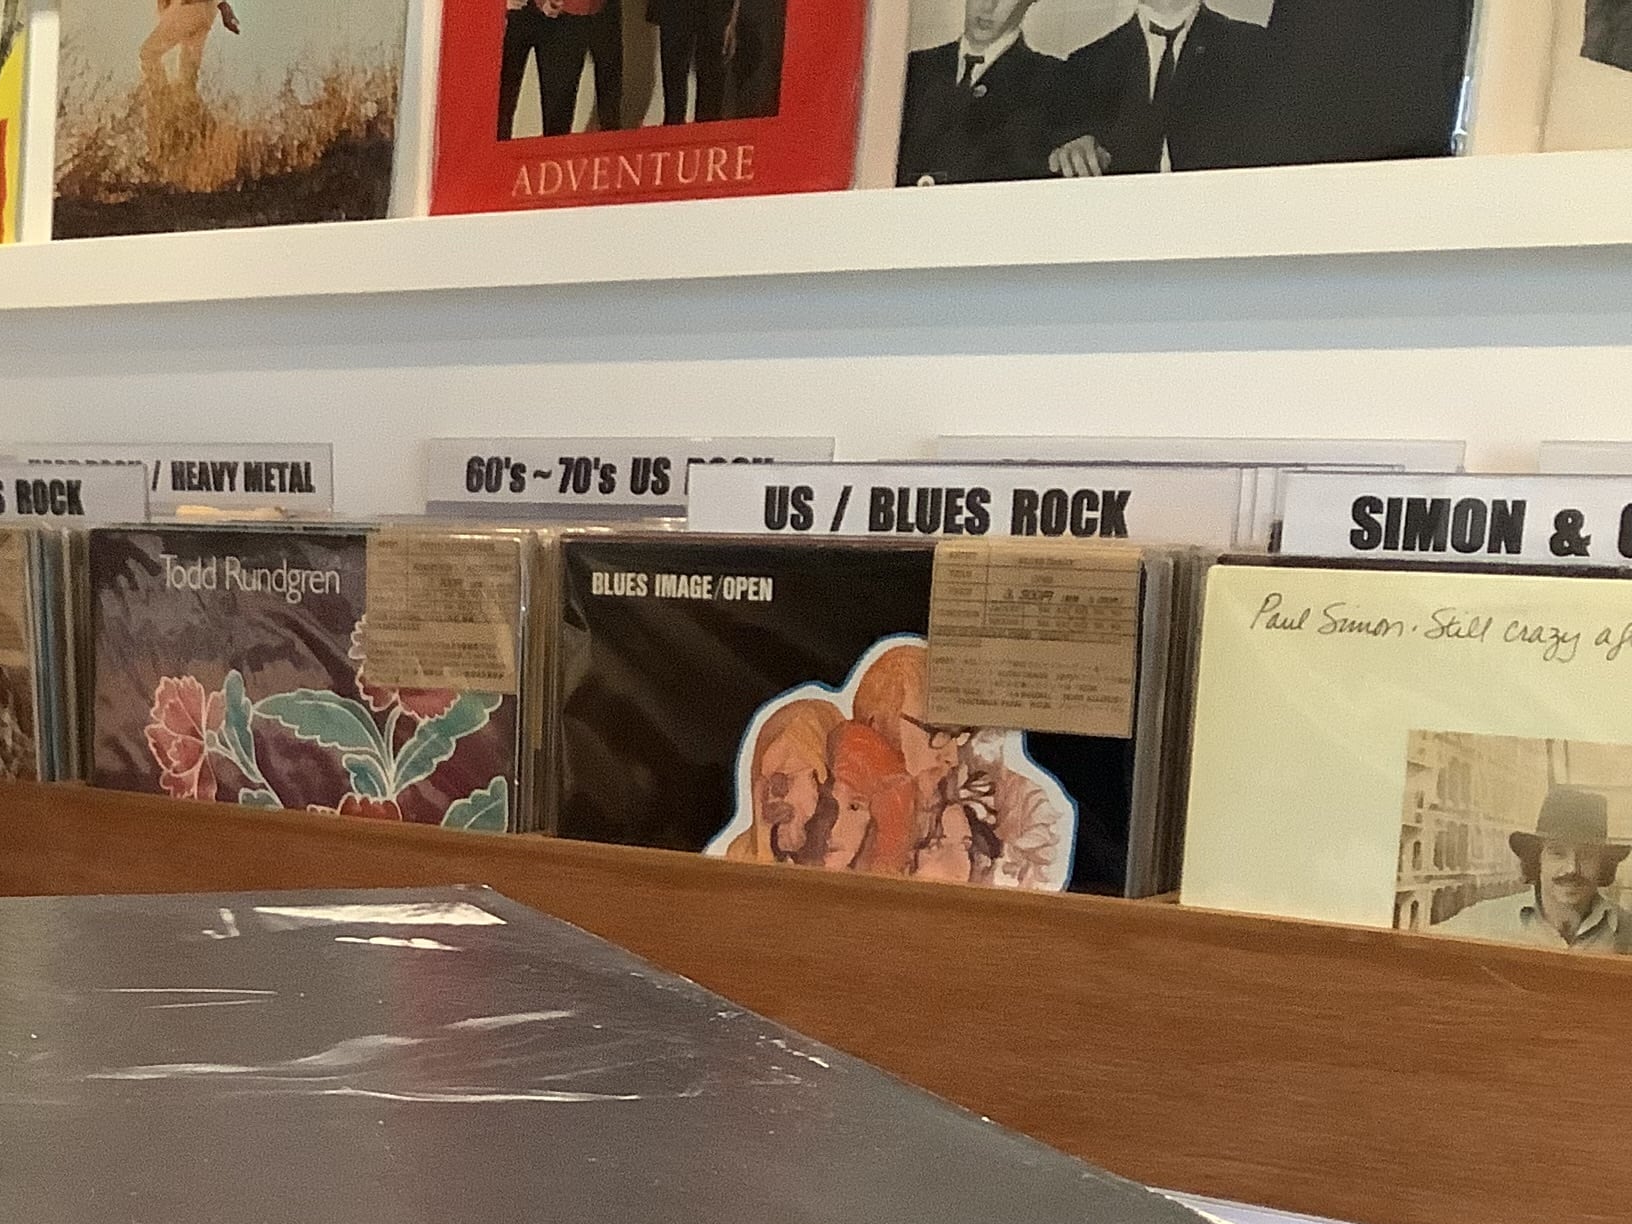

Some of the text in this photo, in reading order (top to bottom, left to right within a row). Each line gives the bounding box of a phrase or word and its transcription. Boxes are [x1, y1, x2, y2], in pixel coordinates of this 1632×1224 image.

[512, 144, 756, 198] ADVENTURE
[15, 478, 86, 517] ROCK
[171, 461, 238, 493] HEAVY
[244, 460, 317, 494] METAL
[629, 456, 671, 496] US
[764, 484, 815, 532] US
[868, 486, 992, 535] BLUES
[1010, 488, 1132, 539] ROCK
[1349, 495, 1528, 555] SIMON
[1549, 508, 1592, 558] &
[159, 554, 341, 605] Todd Rundgren
[591, 571, 649, 597] BLUES
[1249, 592, 1312, 631] Paul
[1423, 606, 1494, 643] Still
[1502, 619, 1582, 663] crazy
